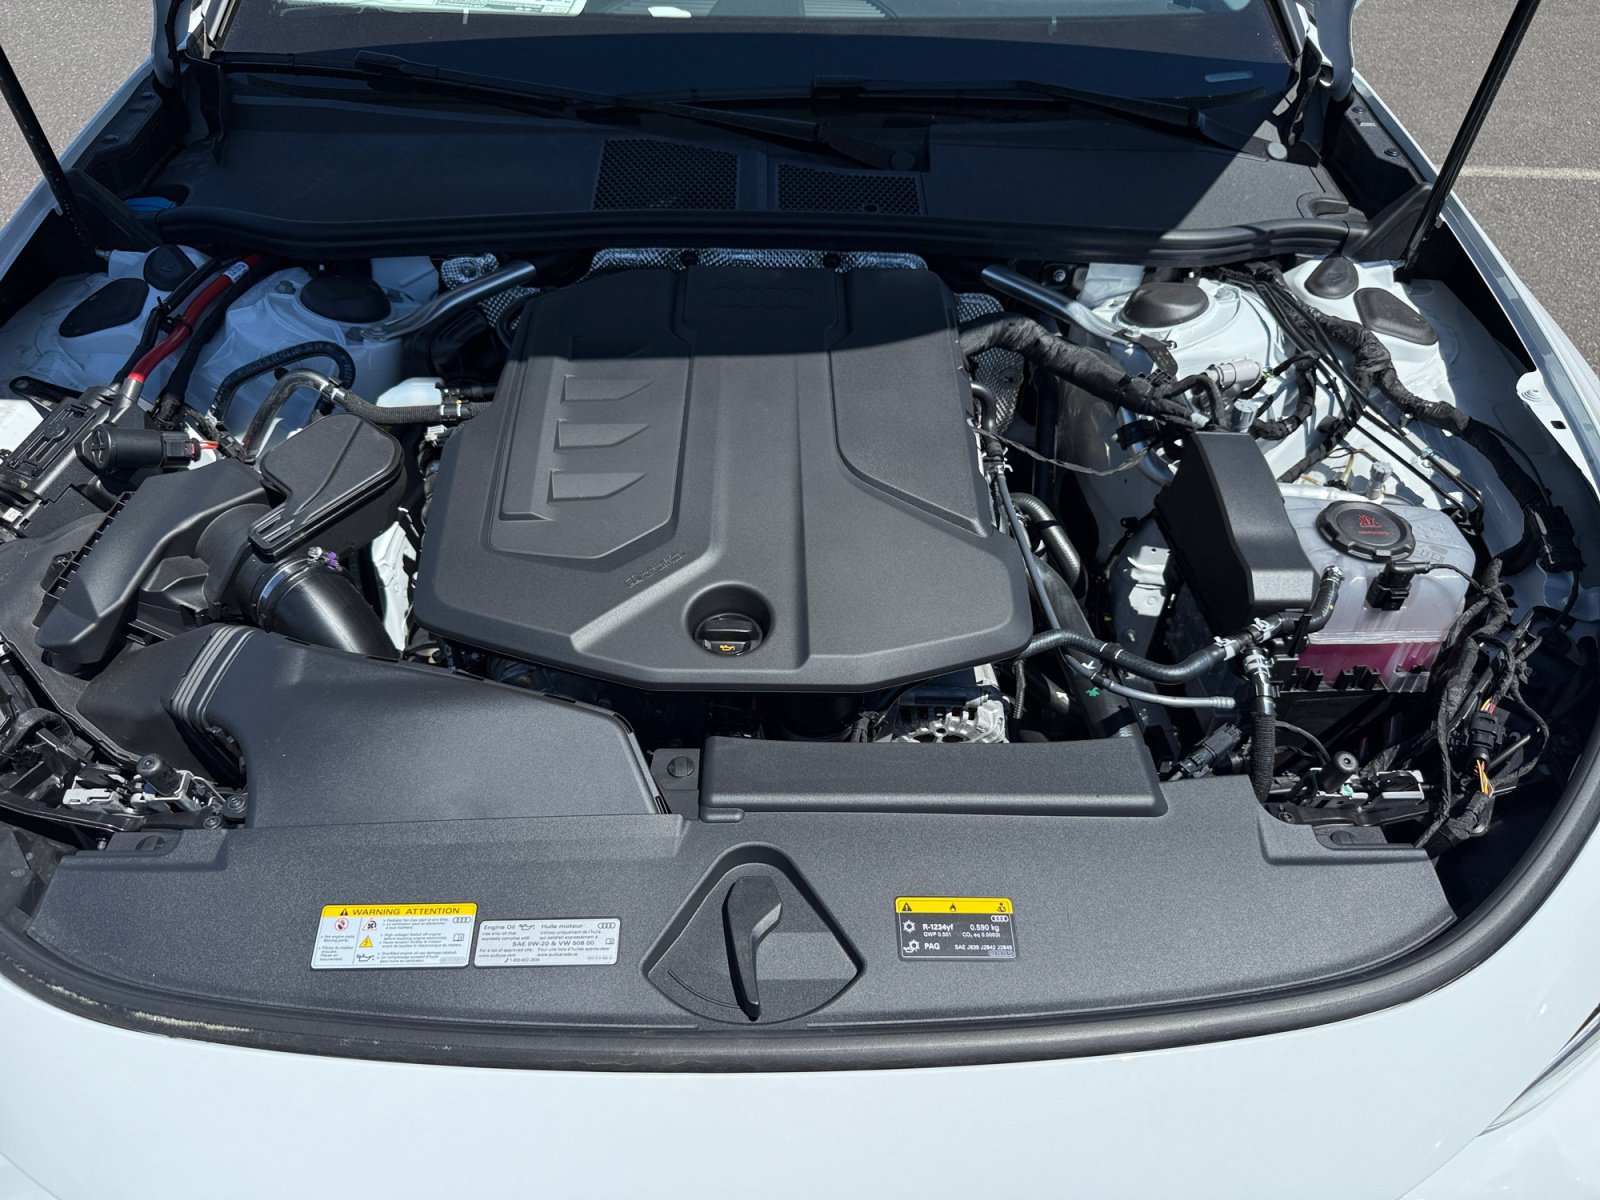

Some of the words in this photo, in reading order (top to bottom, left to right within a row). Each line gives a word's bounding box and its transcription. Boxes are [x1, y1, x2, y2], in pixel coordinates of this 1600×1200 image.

[406, 907, 460, 915] ATTENTION
[922, 924, 954, 932] R-1234yf
[990, 924, 1000, 932] kg
